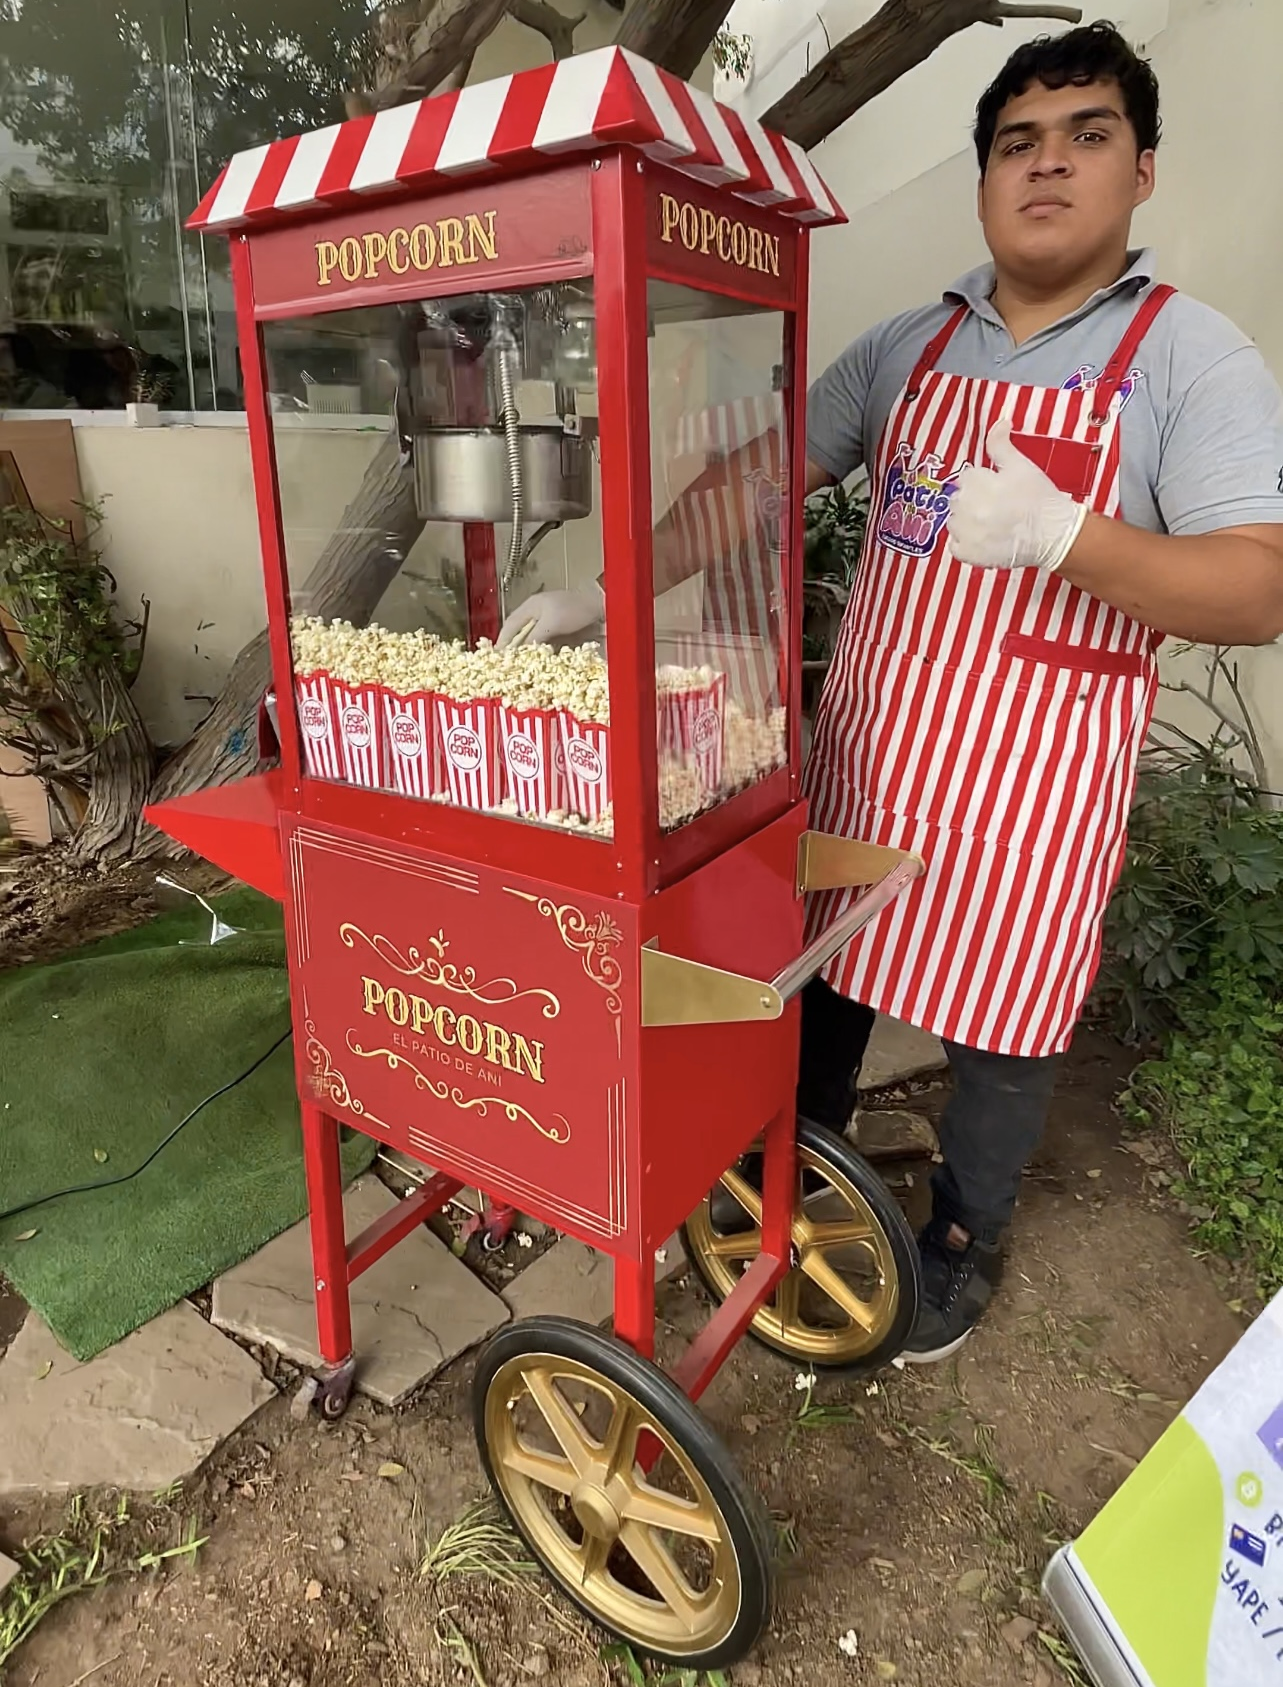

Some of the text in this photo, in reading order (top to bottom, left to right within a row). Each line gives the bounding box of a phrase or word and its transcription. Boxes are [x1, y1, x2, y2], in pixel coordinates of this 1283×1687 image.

[659, 192, 780, 277] POPCORN
[314, 210, 499, 286] POPCORN
[305, 706, 321, 716] POP
[303, 716, 325, 727] CORN
[346, 714, 365, 724] POP
[345, 724, 368, 735] CORN
[396, 722, 414, 733] POP
[394, 732, 419, 744] CORN
[453, 733, 475, 746] POP
[450, 744, 479, 759] CORN
[513, 740, 533, 755] POP
[573, 744, 595, 760] POP
[509, 750, 536, 769] CORN
[570, 753, 599, 774] CORN
[361, 975, 546, 1084] POPCORN
[393, 1032, 502, 1087] EL PATIO DE ANI
[1221, 1559, 1269, 1626] YAPE
